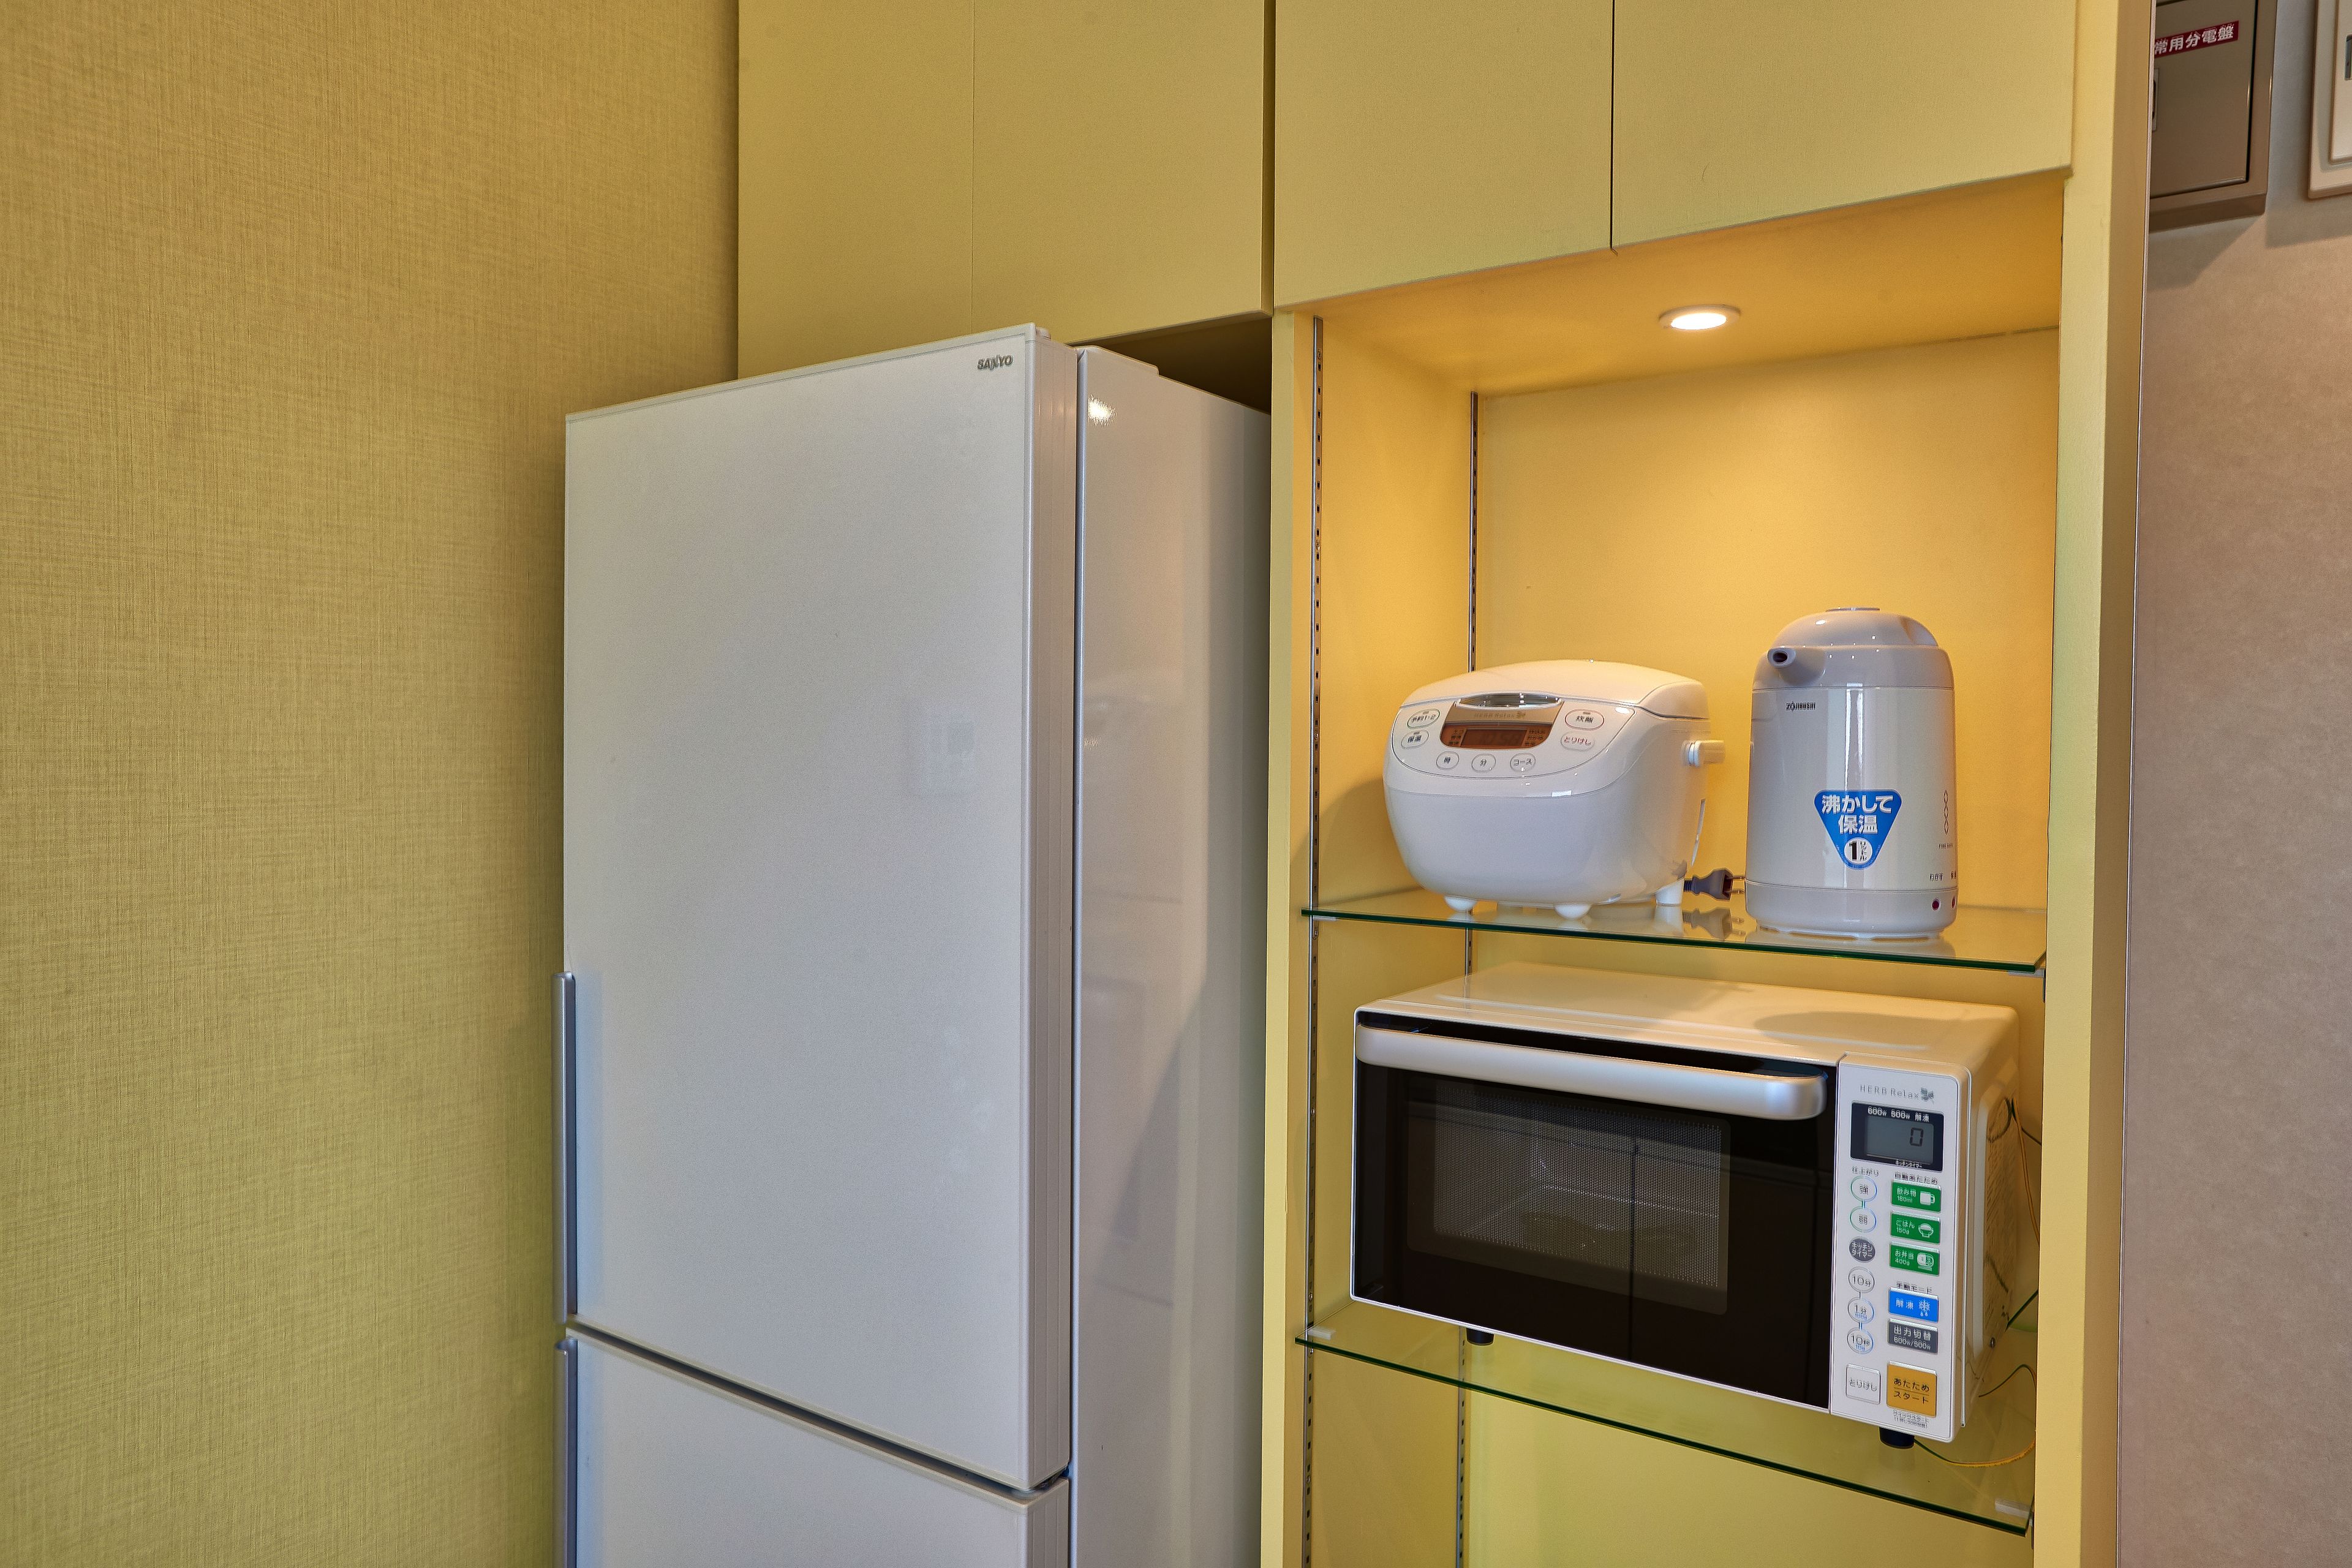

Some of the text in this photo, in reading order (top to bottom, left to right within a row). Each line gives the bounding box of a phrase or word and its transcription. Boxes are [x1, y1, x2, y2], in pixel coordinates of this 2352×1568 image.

[978, 355, 1013, 370] SANYO
[1786, 701, 1816, 711] ZOJIRUSHI
[1564, 736, 1591, 746] とりけし
[1822, 794, 1893, 814] 沸かして
[1838, 815, 1878, 835] 保温
[1860, 1084, 1919, 1100] HERB Relax
[1915, 1112, 1929, 1122] 解凍
[1909, 1127, 1924, 1147] 0
[1852, 1166, 1879, 1177] 仕上がり
[1894, 1172, 1938, 1185] 自動あたため
[1859, 1185, 1869, 1195] 強
[1897, 1186, 1917, 1197] 飲み物
[1858, 1215, 1868, 1225] 弱
[1896, 1218, 1915, 1229] ごはん
[1851, 1241, 1873, 1251] キッチン
[1851, 1249, 1872, 1258] タイマー
[1894, 1250, 1914, 1259] お弁当
[1852, 1275, 1872, 1287] 10分
[1896, 1280, 1933, 1294] 手動モード
[1854, 1303, 1867, 1314] 1分
[1896, 1298, 1914, 1310] 解凍
[1894, 1325, 1931, 1341] 出力切替
[1850, 1335, 1871, 1347] 10秒
[1849, 1377, 1877, 1392] とりけし
[1893, 1378, 1929, 1393] あたため
[1893, 1390, 1929, 1404] スタート
